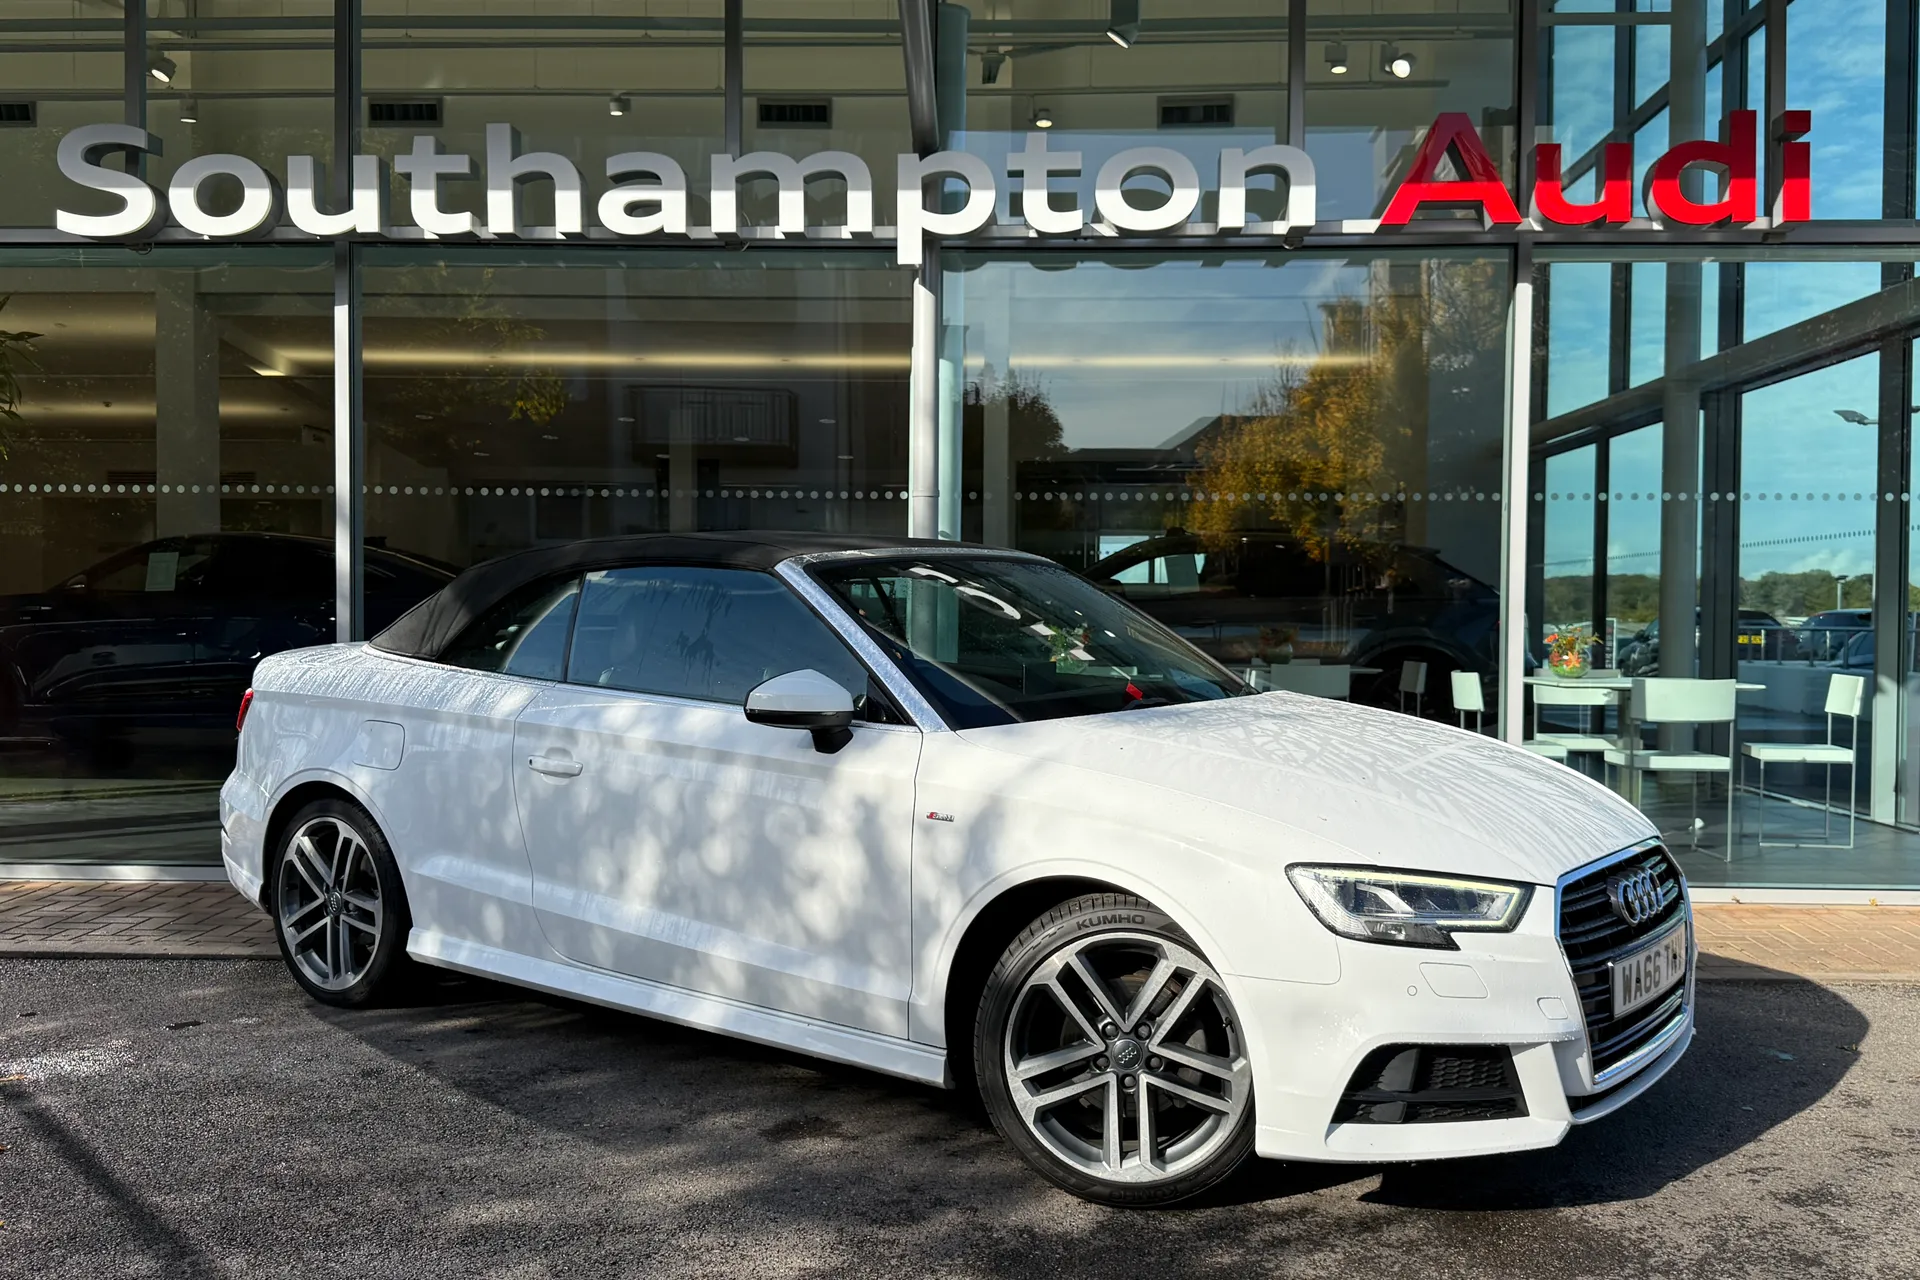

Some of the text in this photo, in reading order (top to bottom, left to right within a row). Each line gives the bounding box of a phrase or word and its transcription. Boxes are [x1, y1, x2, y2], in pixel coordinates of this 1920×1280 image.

[57, 110, 1811, 265] Southampton Audi
[1076, 914, 1146, 930] KUMHO
[1622, 948, 1661, 1006] WA66
